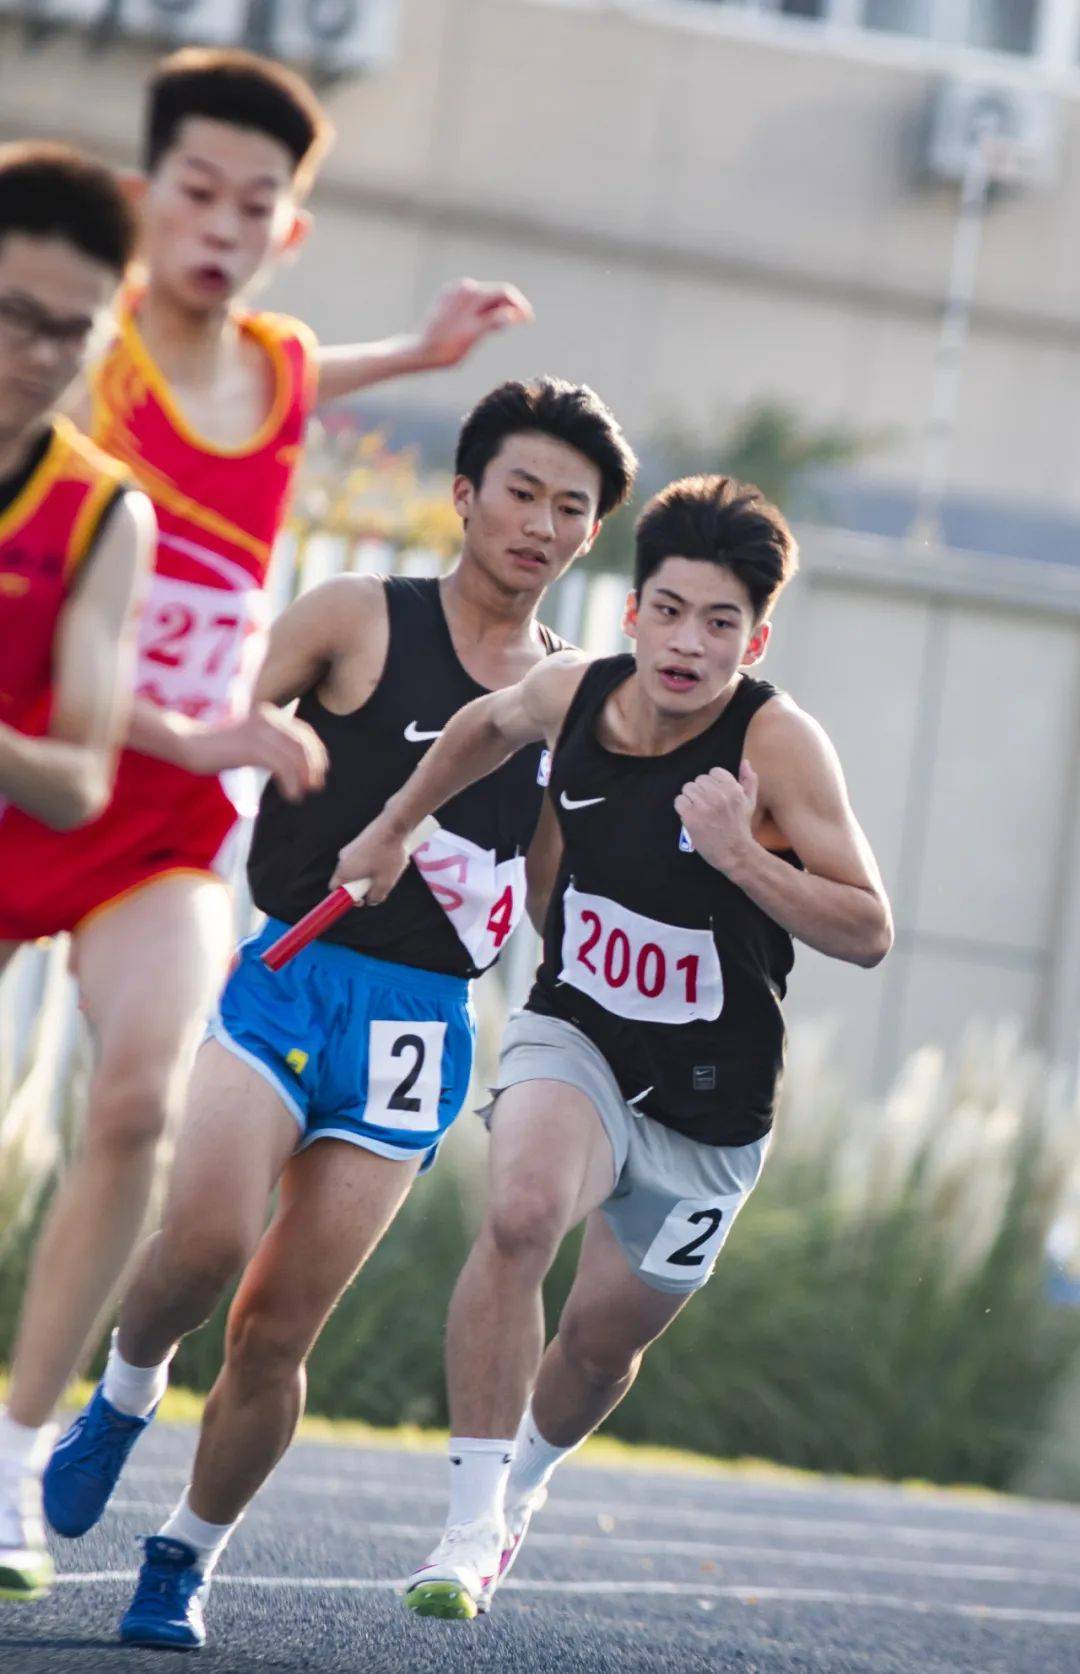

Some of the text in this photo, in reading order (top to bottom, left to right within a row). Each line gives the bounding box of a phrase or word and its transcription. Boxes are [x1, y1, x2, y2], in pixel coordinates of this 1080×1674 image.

[577, 910, 699, 1003] 2001
[387, 1034, 425, 1112] 2
[666, 1208, 722, 1266] 2
